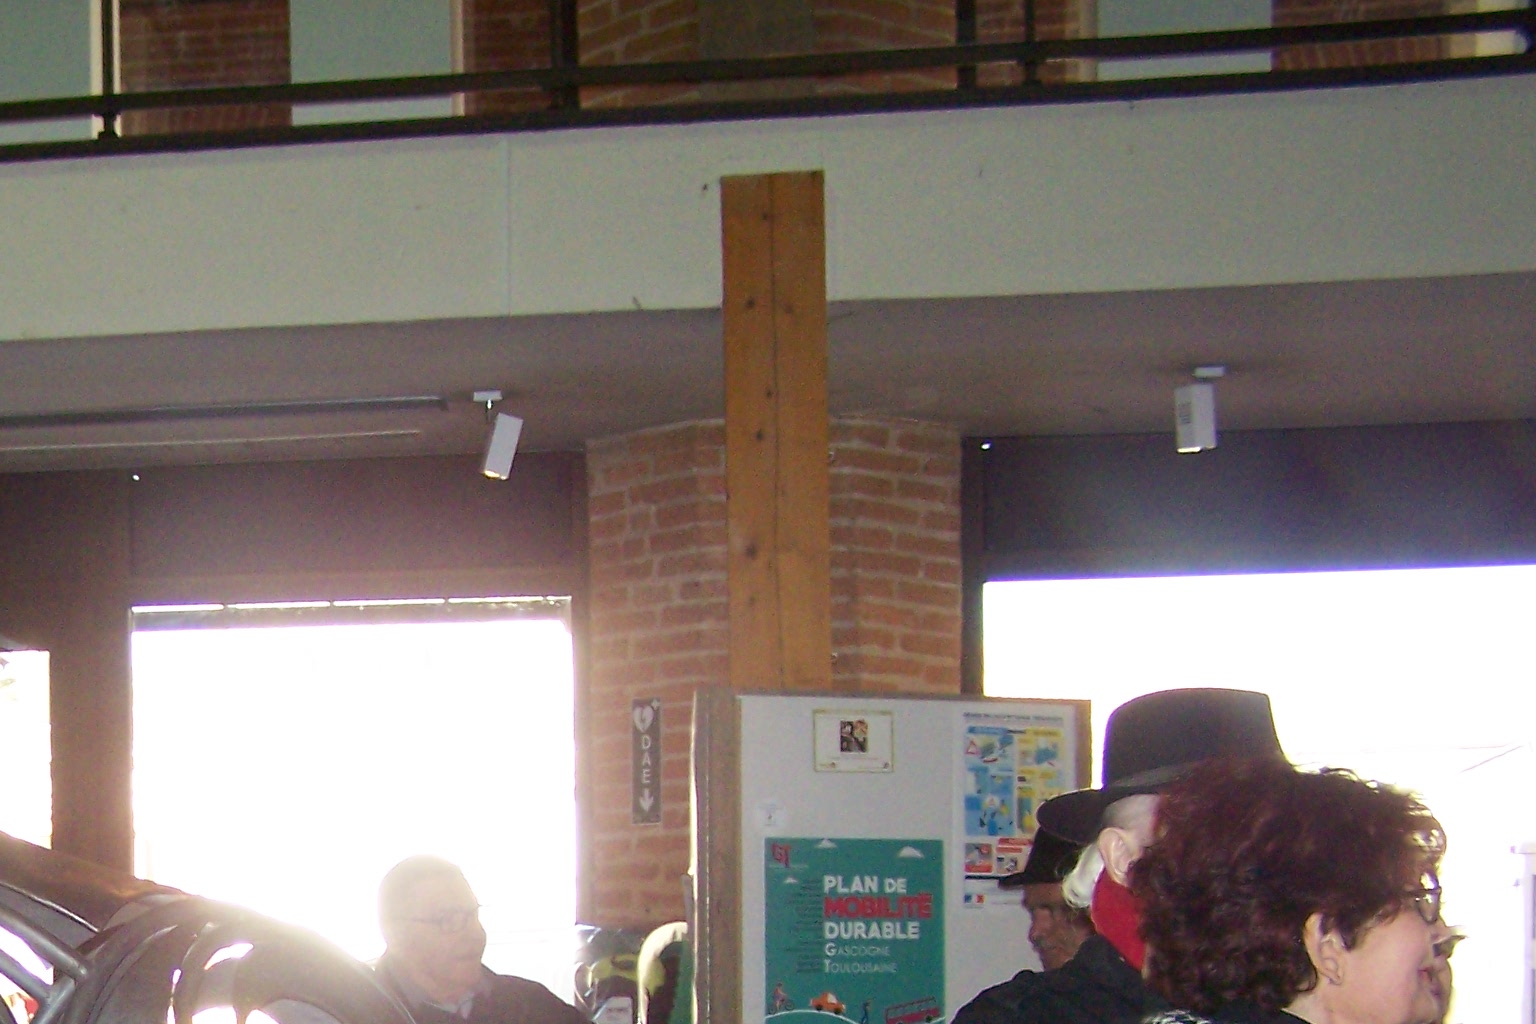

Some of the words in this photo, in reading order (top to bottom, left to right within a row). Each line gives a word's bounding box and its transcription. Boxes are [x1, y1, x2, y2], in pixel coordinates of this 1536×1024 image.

[641, 735, 651, 784] DAE
[823, 875, 878, 894] PLAN
[884, 878, 907, 893] DE
[823, 892, 933, 919] MOBILITÉ
[824, 921, 920, 939] DURABLE
